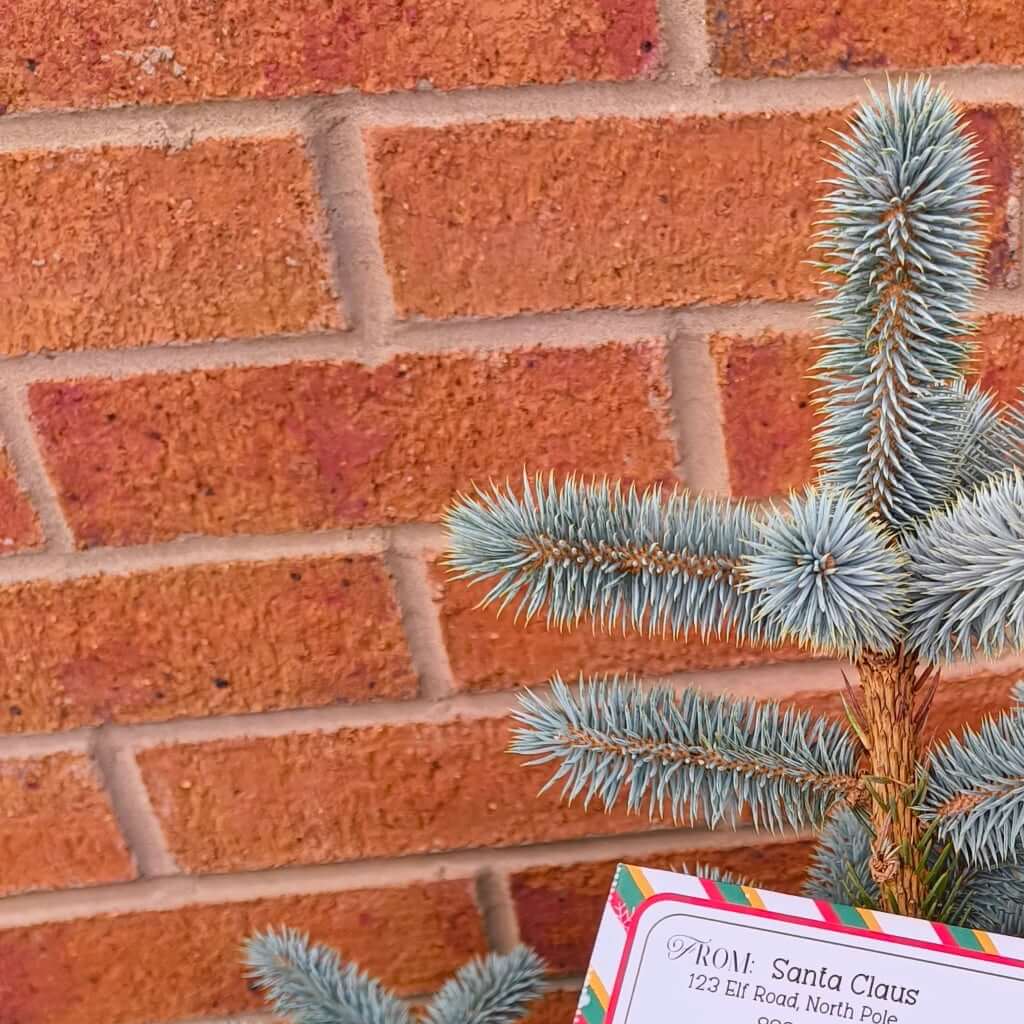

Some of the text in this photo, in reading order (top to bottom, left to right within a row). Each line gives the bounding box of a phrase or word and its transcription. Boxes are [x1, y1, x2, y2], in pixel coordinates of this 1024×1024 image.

[666, 934, 920, 1006] FROM: Santa Claus
[687, 973, 720, 993] 123
[724, 979, 750, 1000] Elf
[753, 985, 800, 1012] Road,
[805, 995, 854, 1020] North
